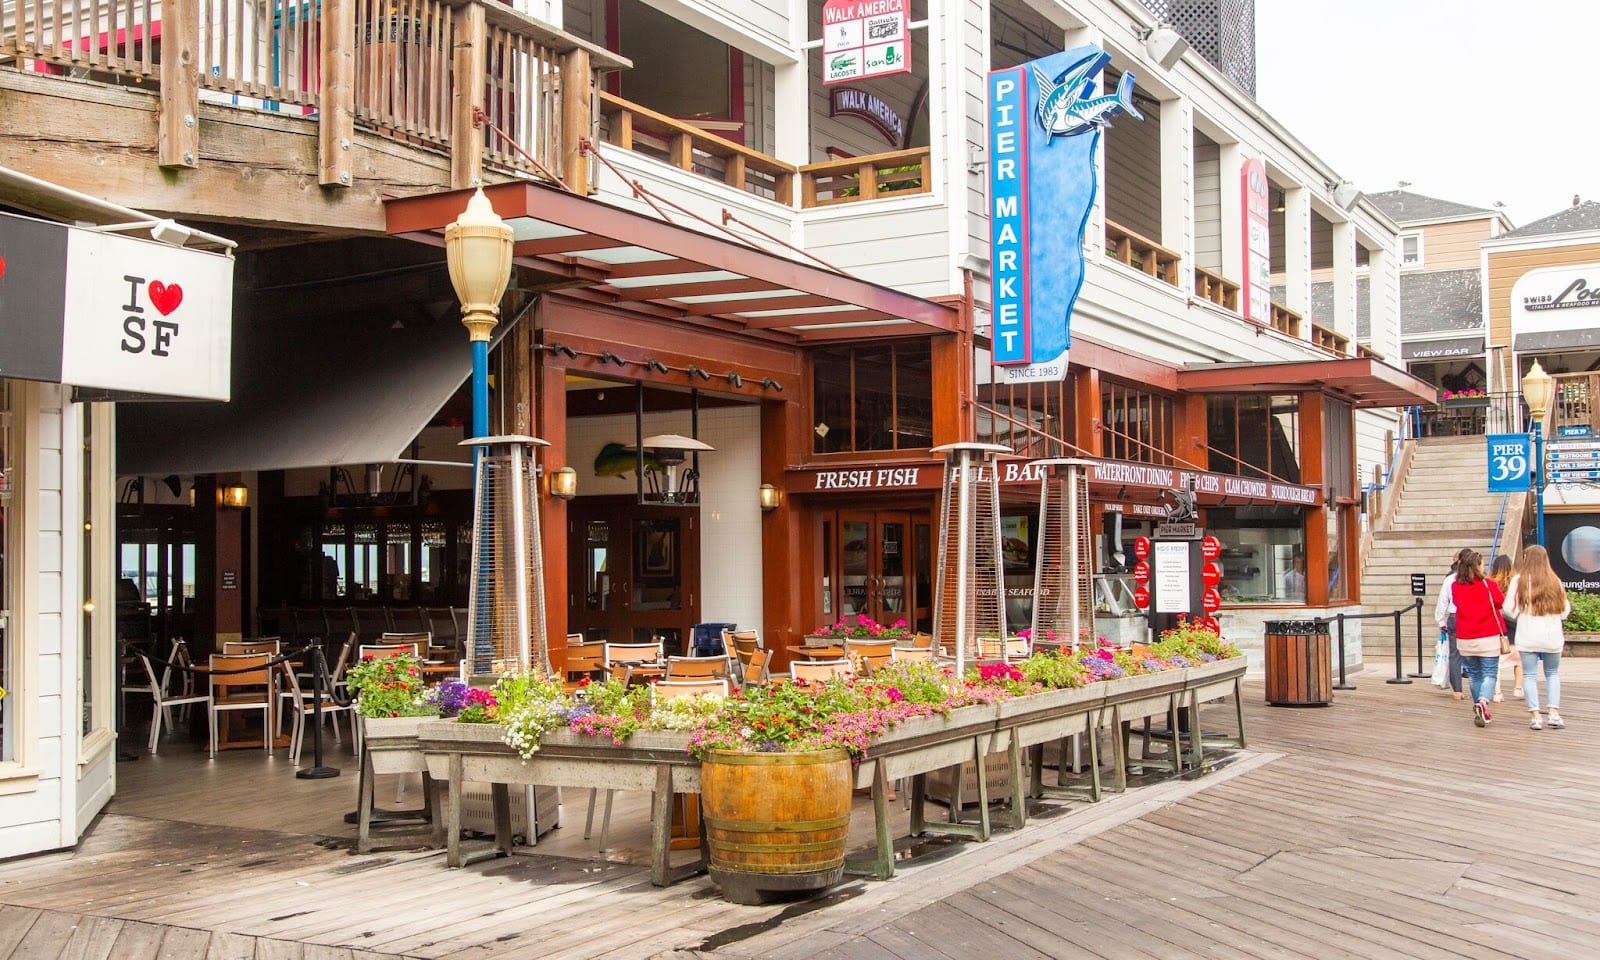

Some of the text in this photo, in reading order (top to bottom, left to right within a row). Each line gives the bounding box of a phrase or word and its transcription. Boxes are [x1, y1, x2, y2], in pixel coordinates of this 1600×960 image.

[826, 0, 903, 23] WALK AMERICA
[831, 69, 857, 78] LACOSTE
[841, 90, 903, 137] WALK AMERICA
[996, 80, 1017, 352] PIER MARKET
[1524, 295, 1552, 304] SWISS
[121, 316, 179, 357] SF
[1412, 348, 1469, 358] VIEW BAR
[1009, 366, 1058, 379] SINCE 1983
[1493, 444, 1525, 456] PIER
[1492, 456, 1527, 481] 39
[815, 470, 872, 489] FRESH
[876, 468, 919, 487] FISH
[1094, 463, 1146, 484] WATERFRONT
[1147, 469, 1173, 487] DINING
[1195, 474, 1201, 489] &
[1201, 475, 1219, 492] CHIPS
[1225, 478, 1240, 495] CLAM
[1240, 480, 1267, 497] CHOWDER
[1271, 484, 1300, 501] SOURDOUGH
[1300, 488, 1315, 503] BREAD
[1160, 525, 1193, 533] PIER MARKET
